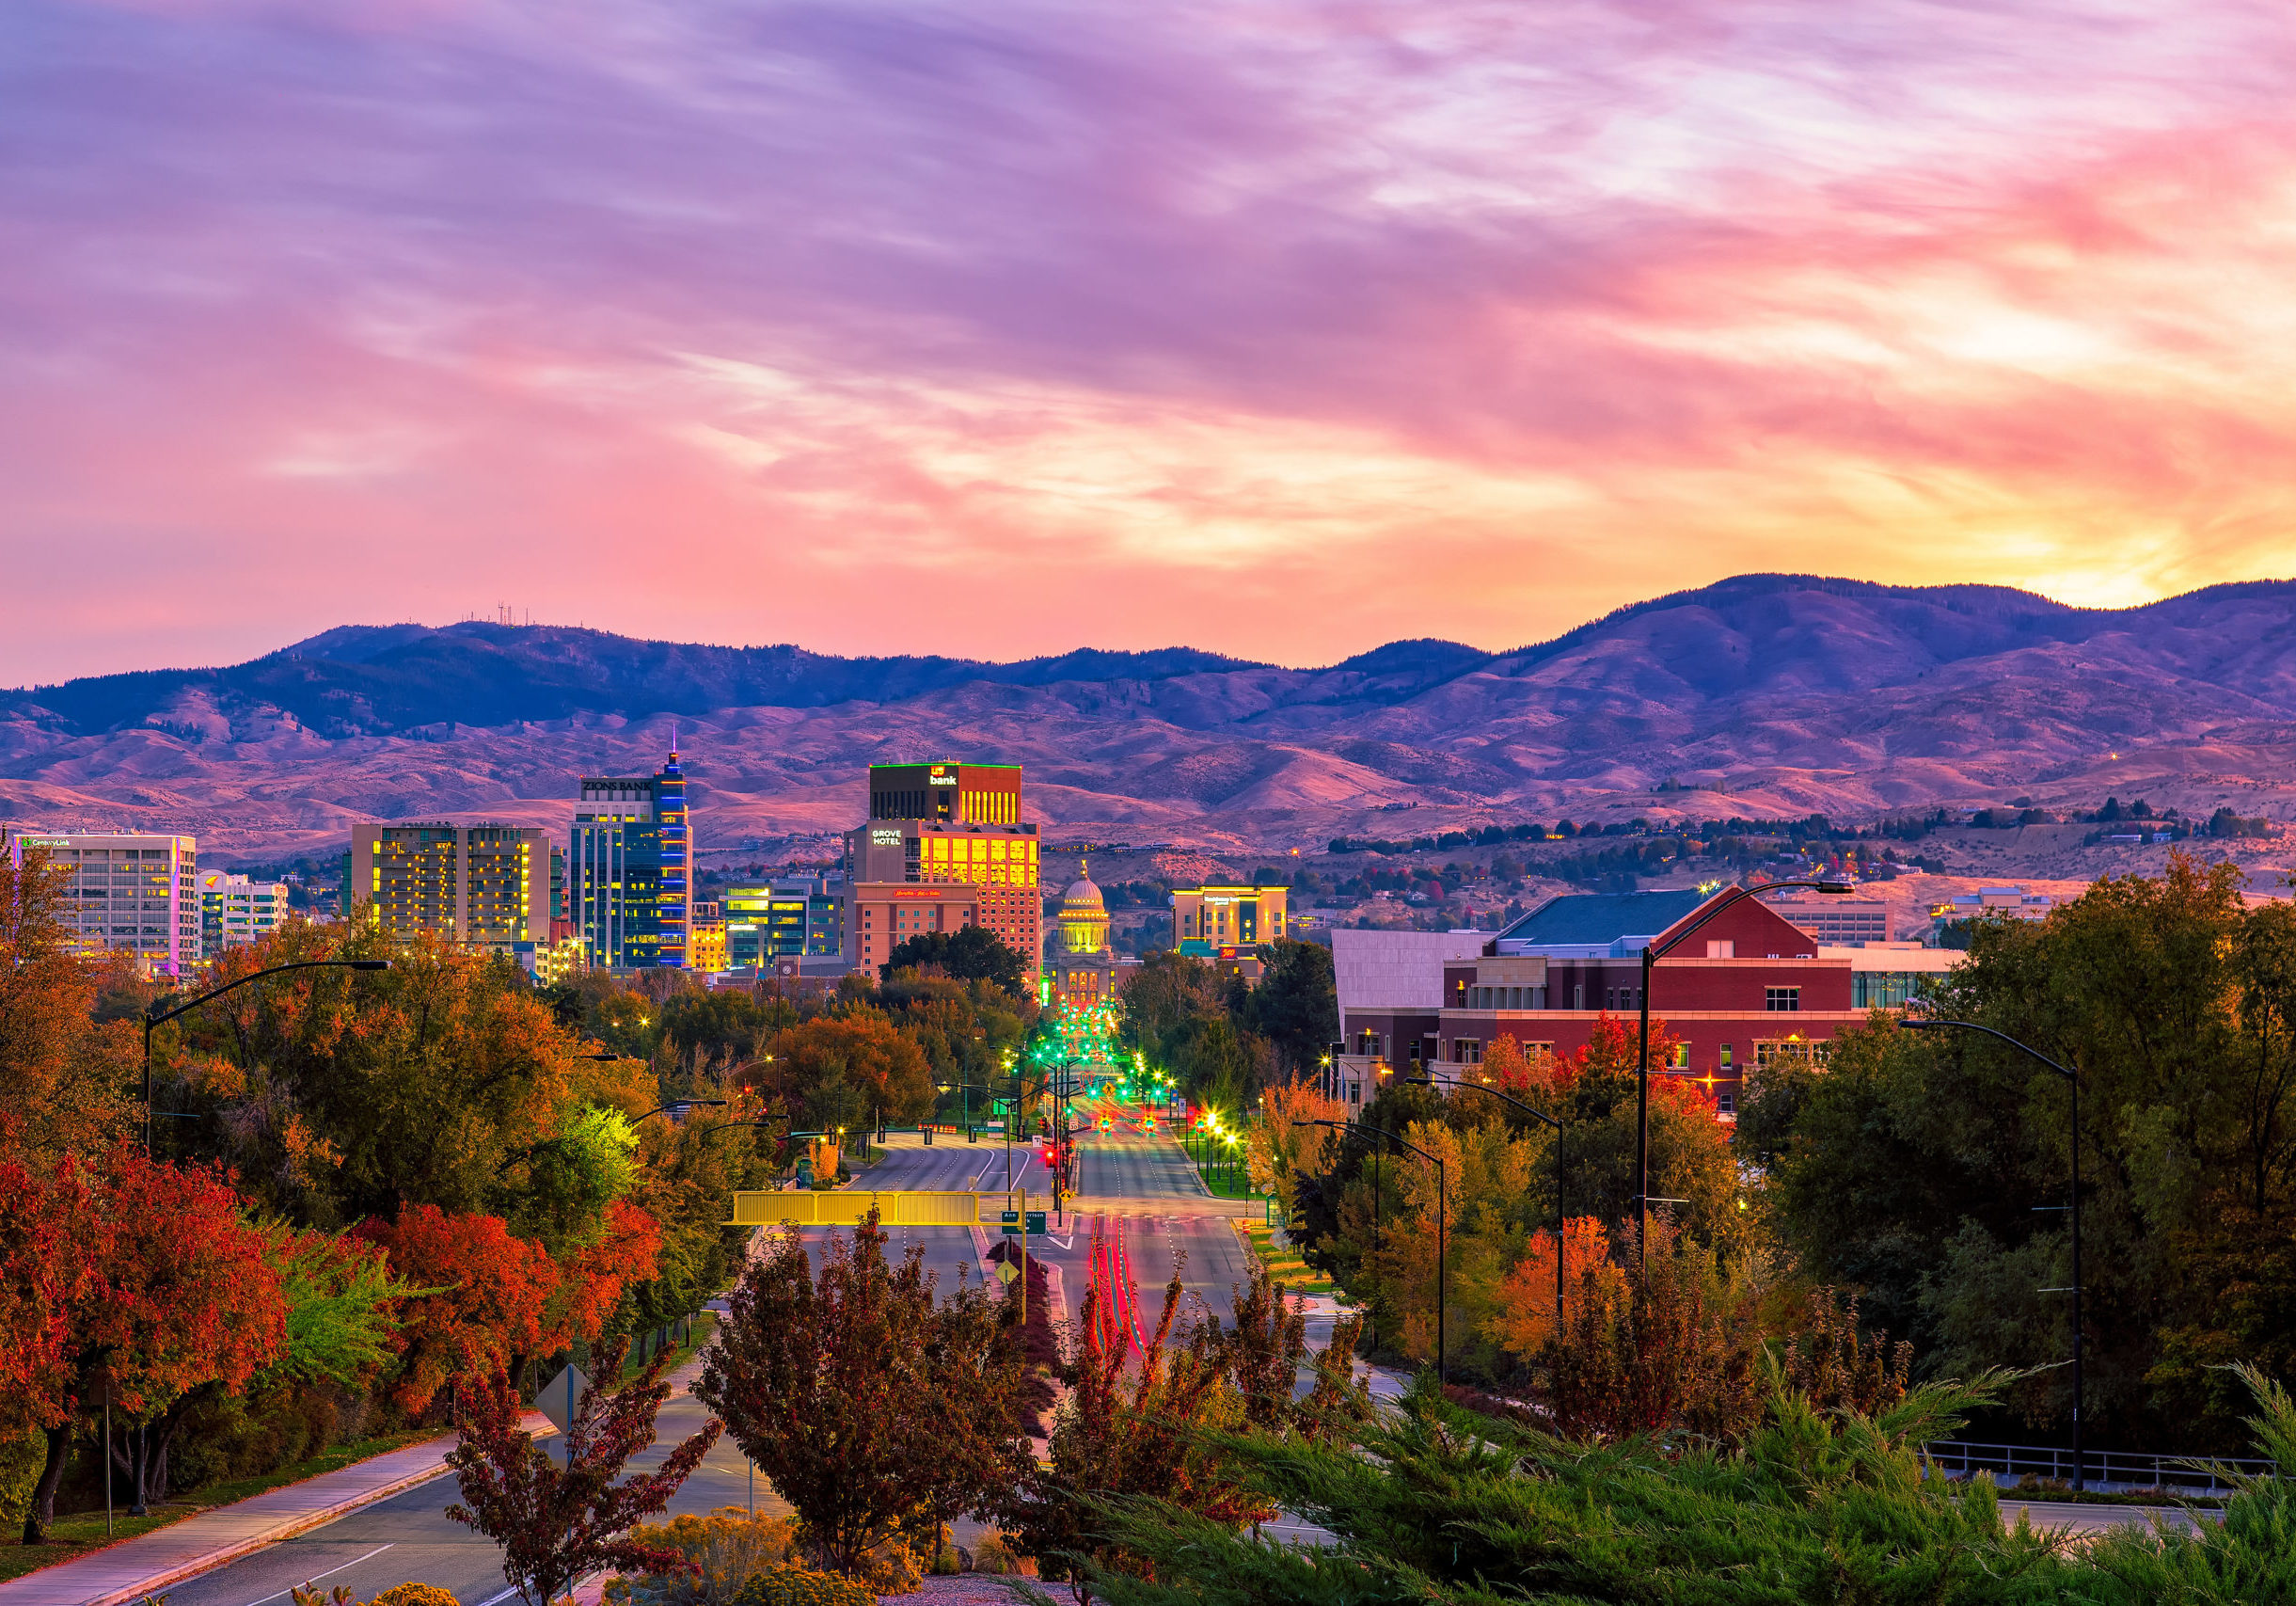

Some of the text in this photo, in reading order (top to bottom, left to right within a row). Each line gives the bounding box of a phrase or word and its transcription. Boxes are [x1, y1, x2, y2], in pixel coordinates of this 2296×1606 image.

[930, 767, 944, 775] us
[929, 775, 957, 785] bank
[583, 781, 652, 791] ZIONS BANK
[32, 838, 71, 847] CenturyLink
